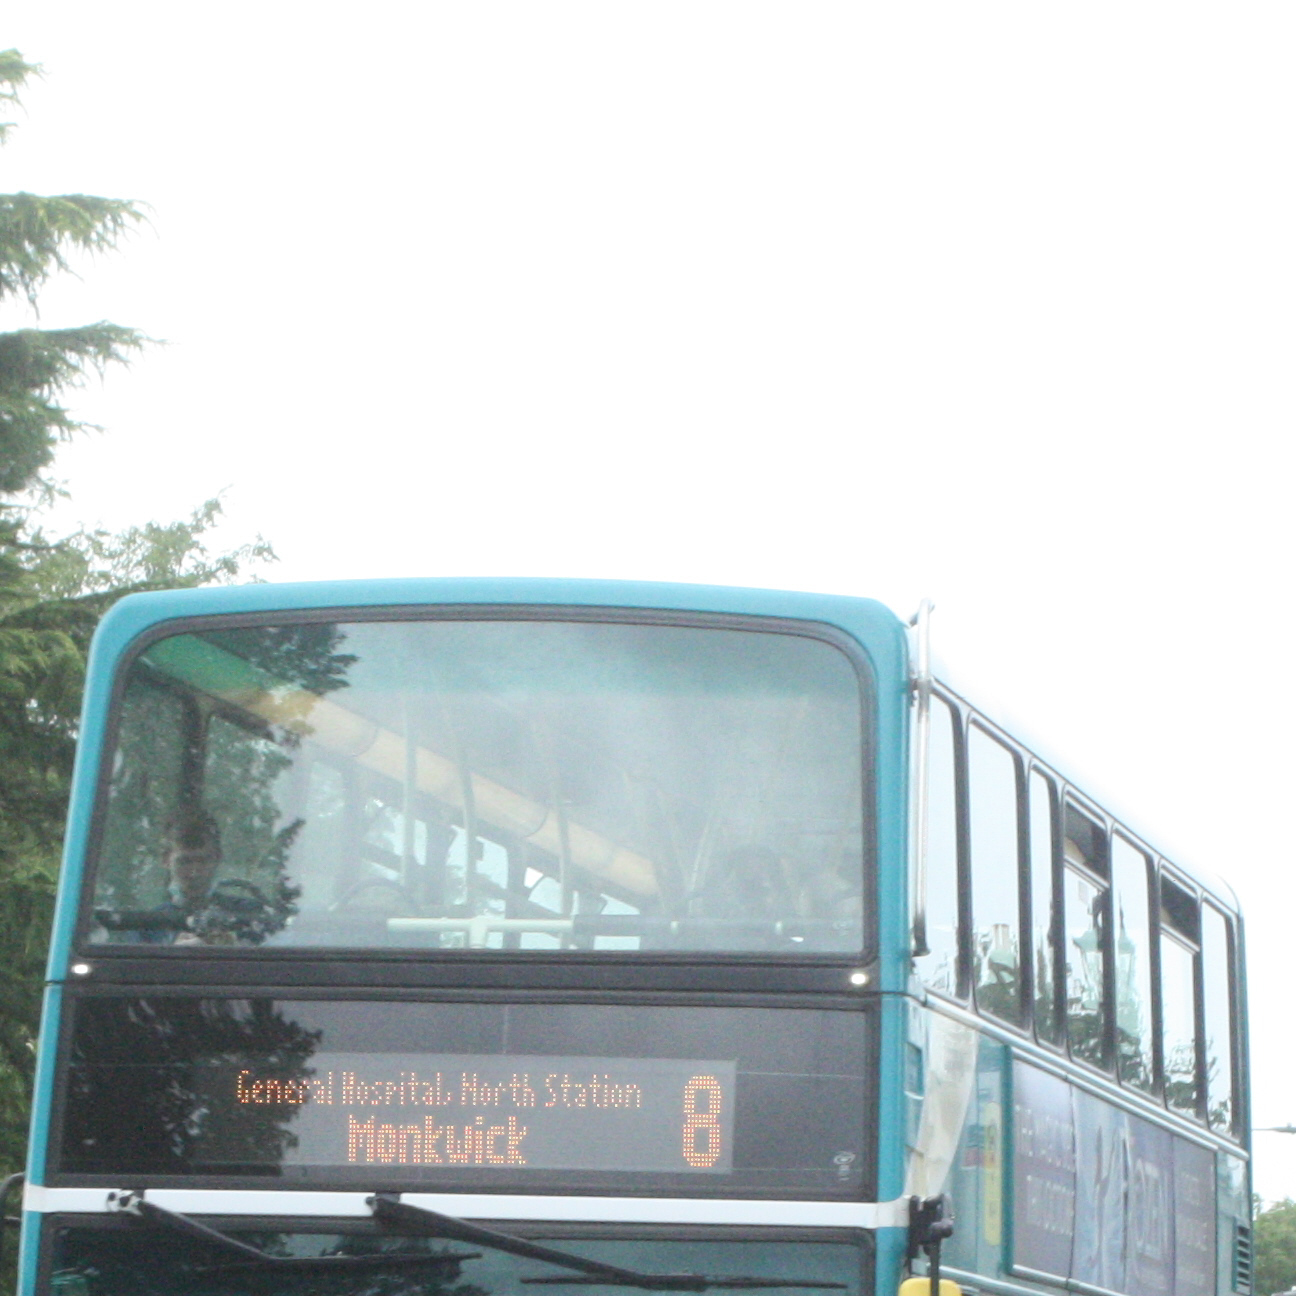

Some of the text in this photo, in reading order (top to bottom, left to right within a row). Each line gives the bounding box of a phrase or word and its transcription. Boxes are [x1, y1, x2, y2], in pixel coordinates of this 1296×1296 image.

[237, 1070, 641, 1108] General Hospital, North Station
[348, 1114, 528, 1165] Monkwick
[682, 1075, 722, 1168] 8
